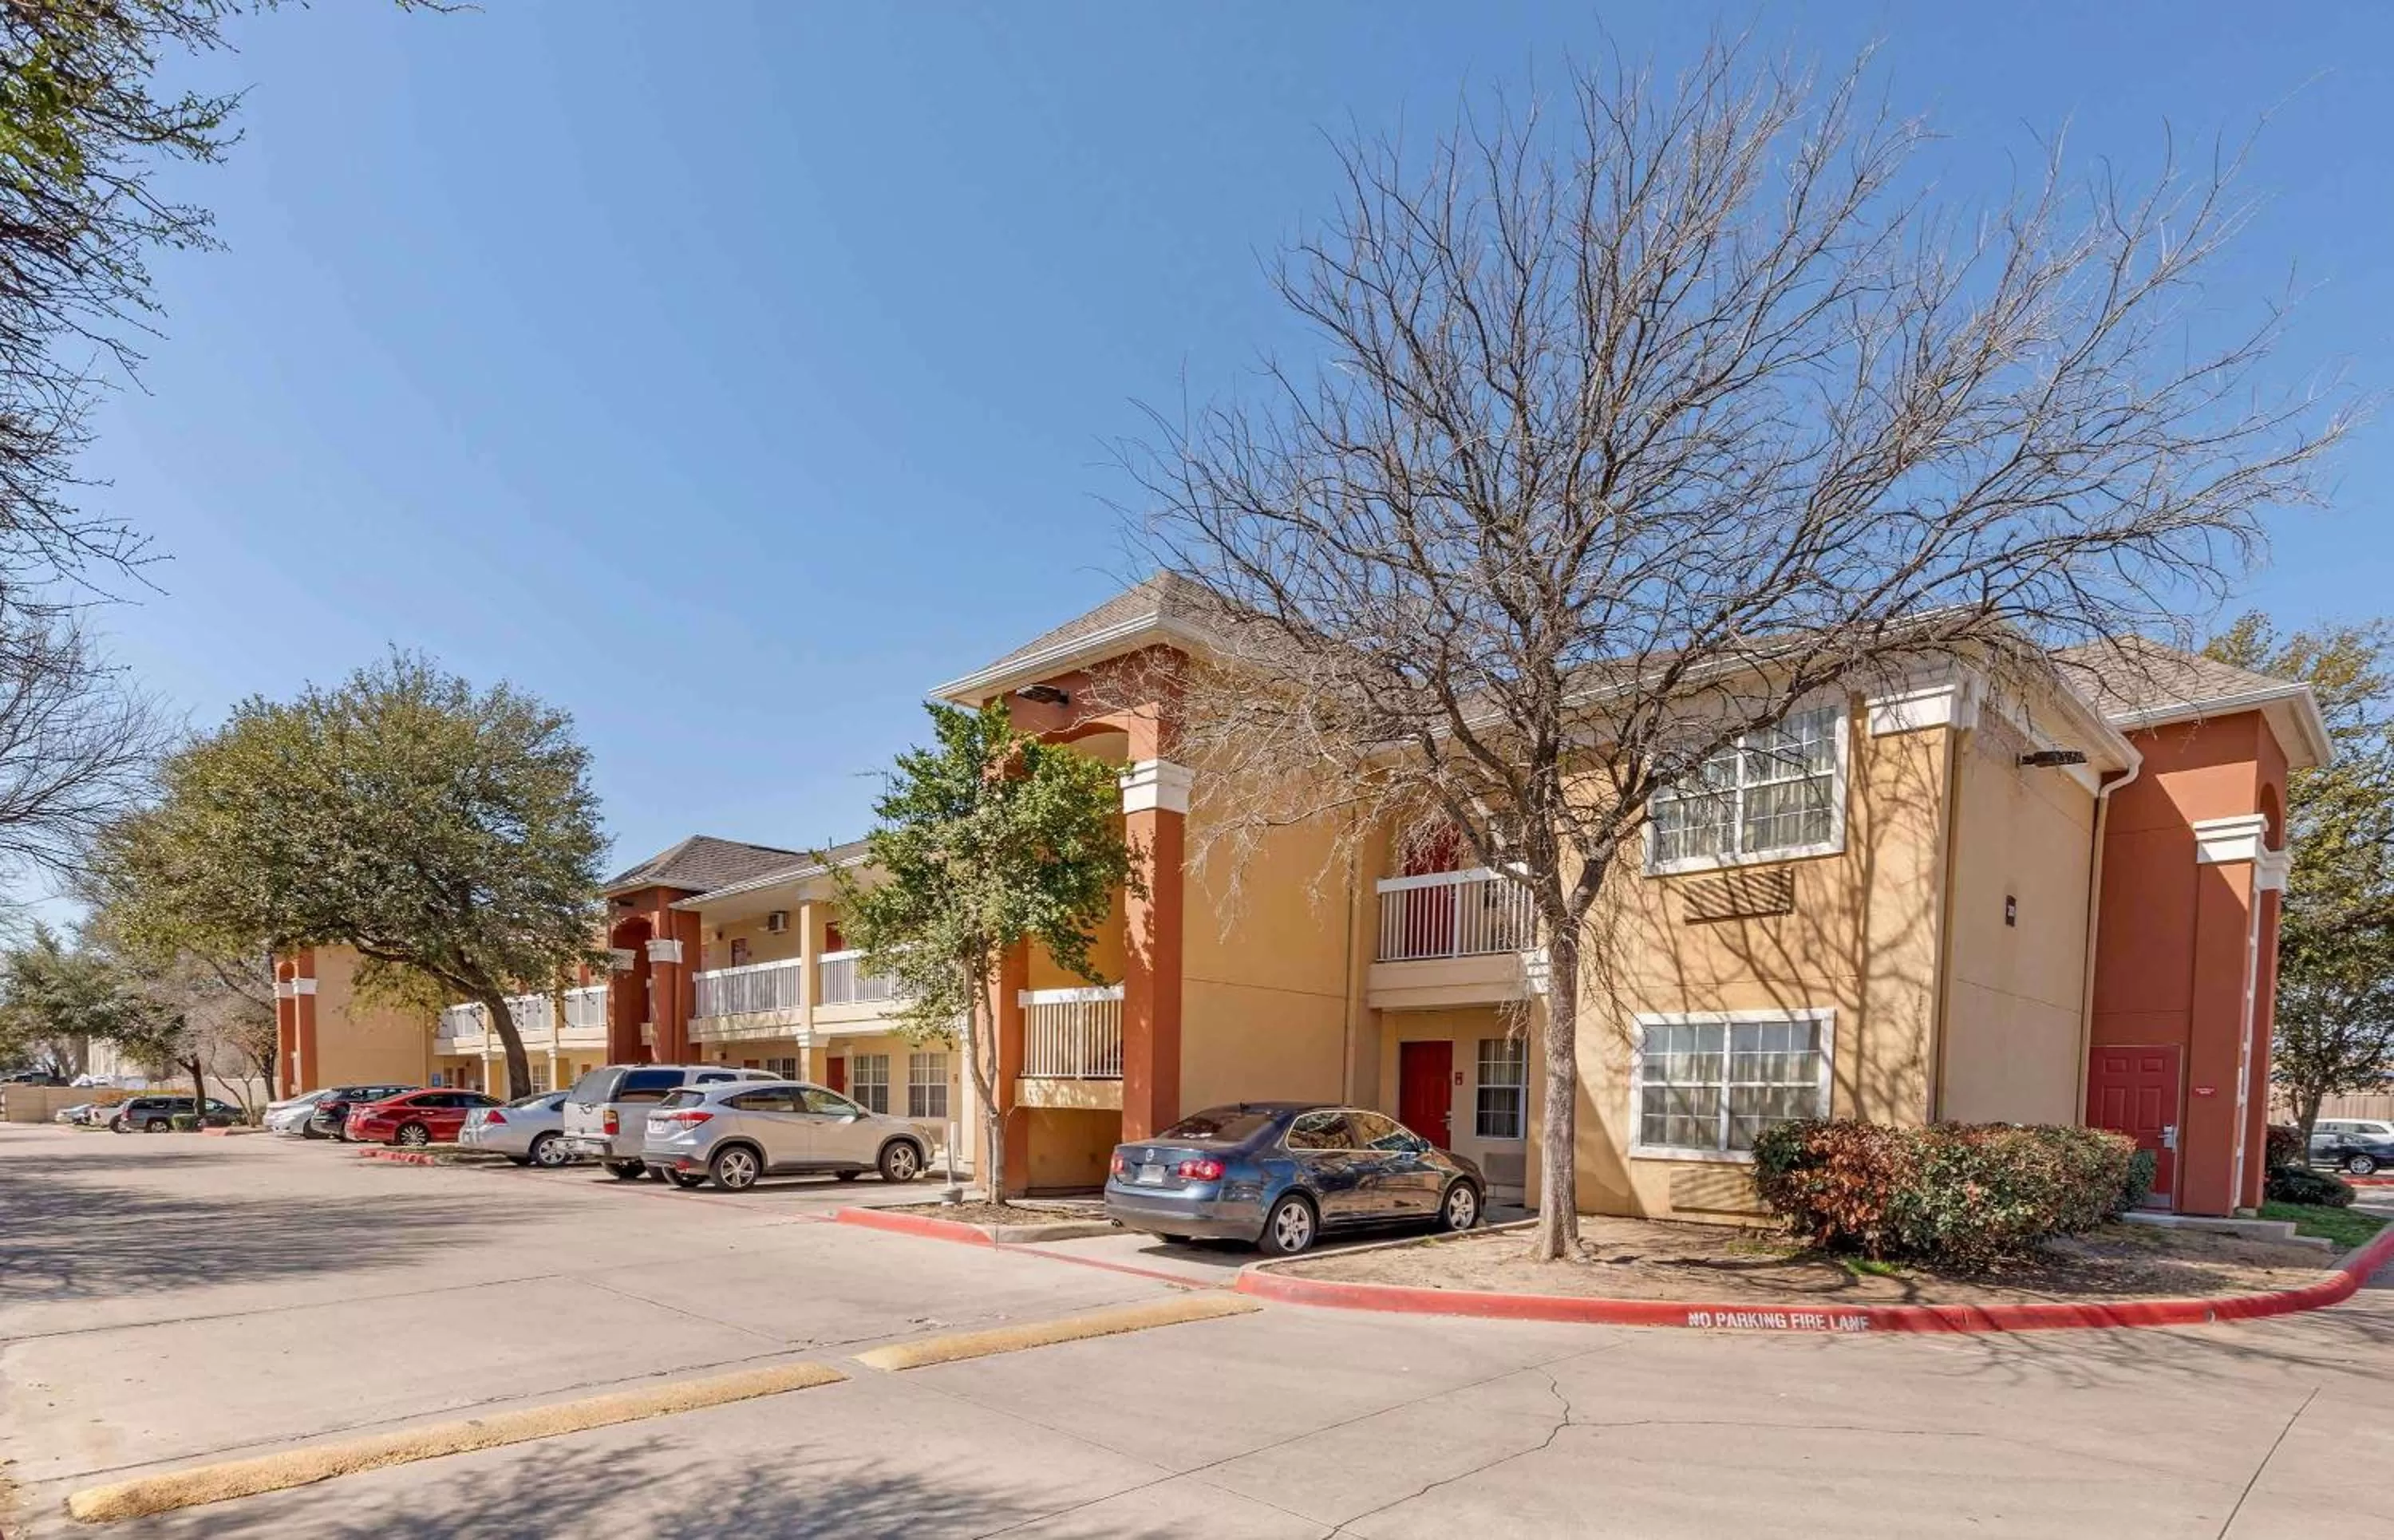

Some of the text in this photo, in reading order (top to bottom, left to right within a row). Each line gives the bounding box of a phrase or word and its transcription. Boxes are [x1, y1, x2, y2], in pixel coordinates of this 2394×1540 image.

[1688, 1312, 1869, 1331] NO PARKING FIRE LANE
